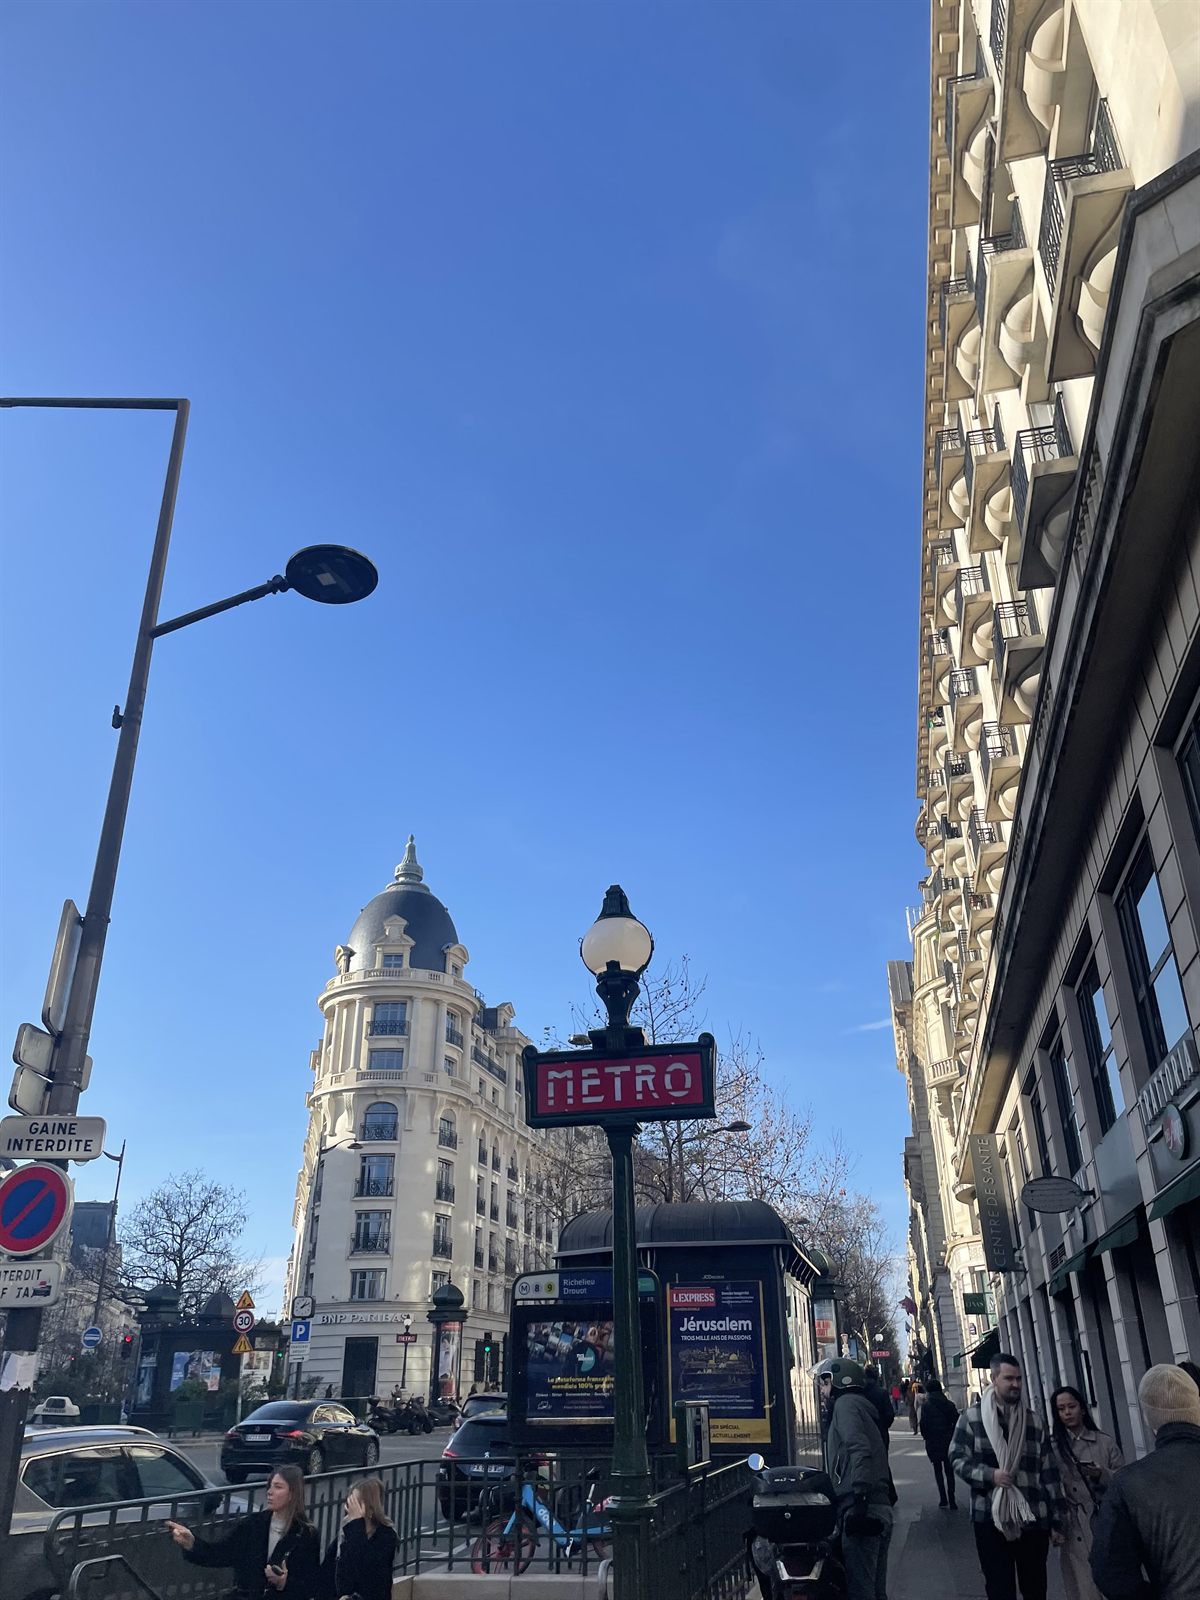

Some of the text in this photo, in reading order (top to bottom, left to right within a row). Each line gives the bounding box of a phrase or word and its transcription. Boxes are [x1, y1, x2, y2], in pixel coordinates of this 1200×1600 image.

[547, 1062, 692, 1106] METRO
[1139, 1039, 1194, 1126] TRATTORIA
[29, 1122, 78, 1135] GAINE
[7, 1138, 93, 1152] INTERDITE
[977, 1138, 1006, 1267] CENTRE DE SANTE
[0, 1269, 42, 1281] TERDIT
[534, 1284, 540, 1292] 8
[547, 1283, 553, 1292] 9
[239, 1317, 250, 1326] 30
[320, 1312, 408, 1324] BNP PARIBAS
[680, 1316, 752, 1331] Jérusalem
[296, 1325, 306, 1338] P
